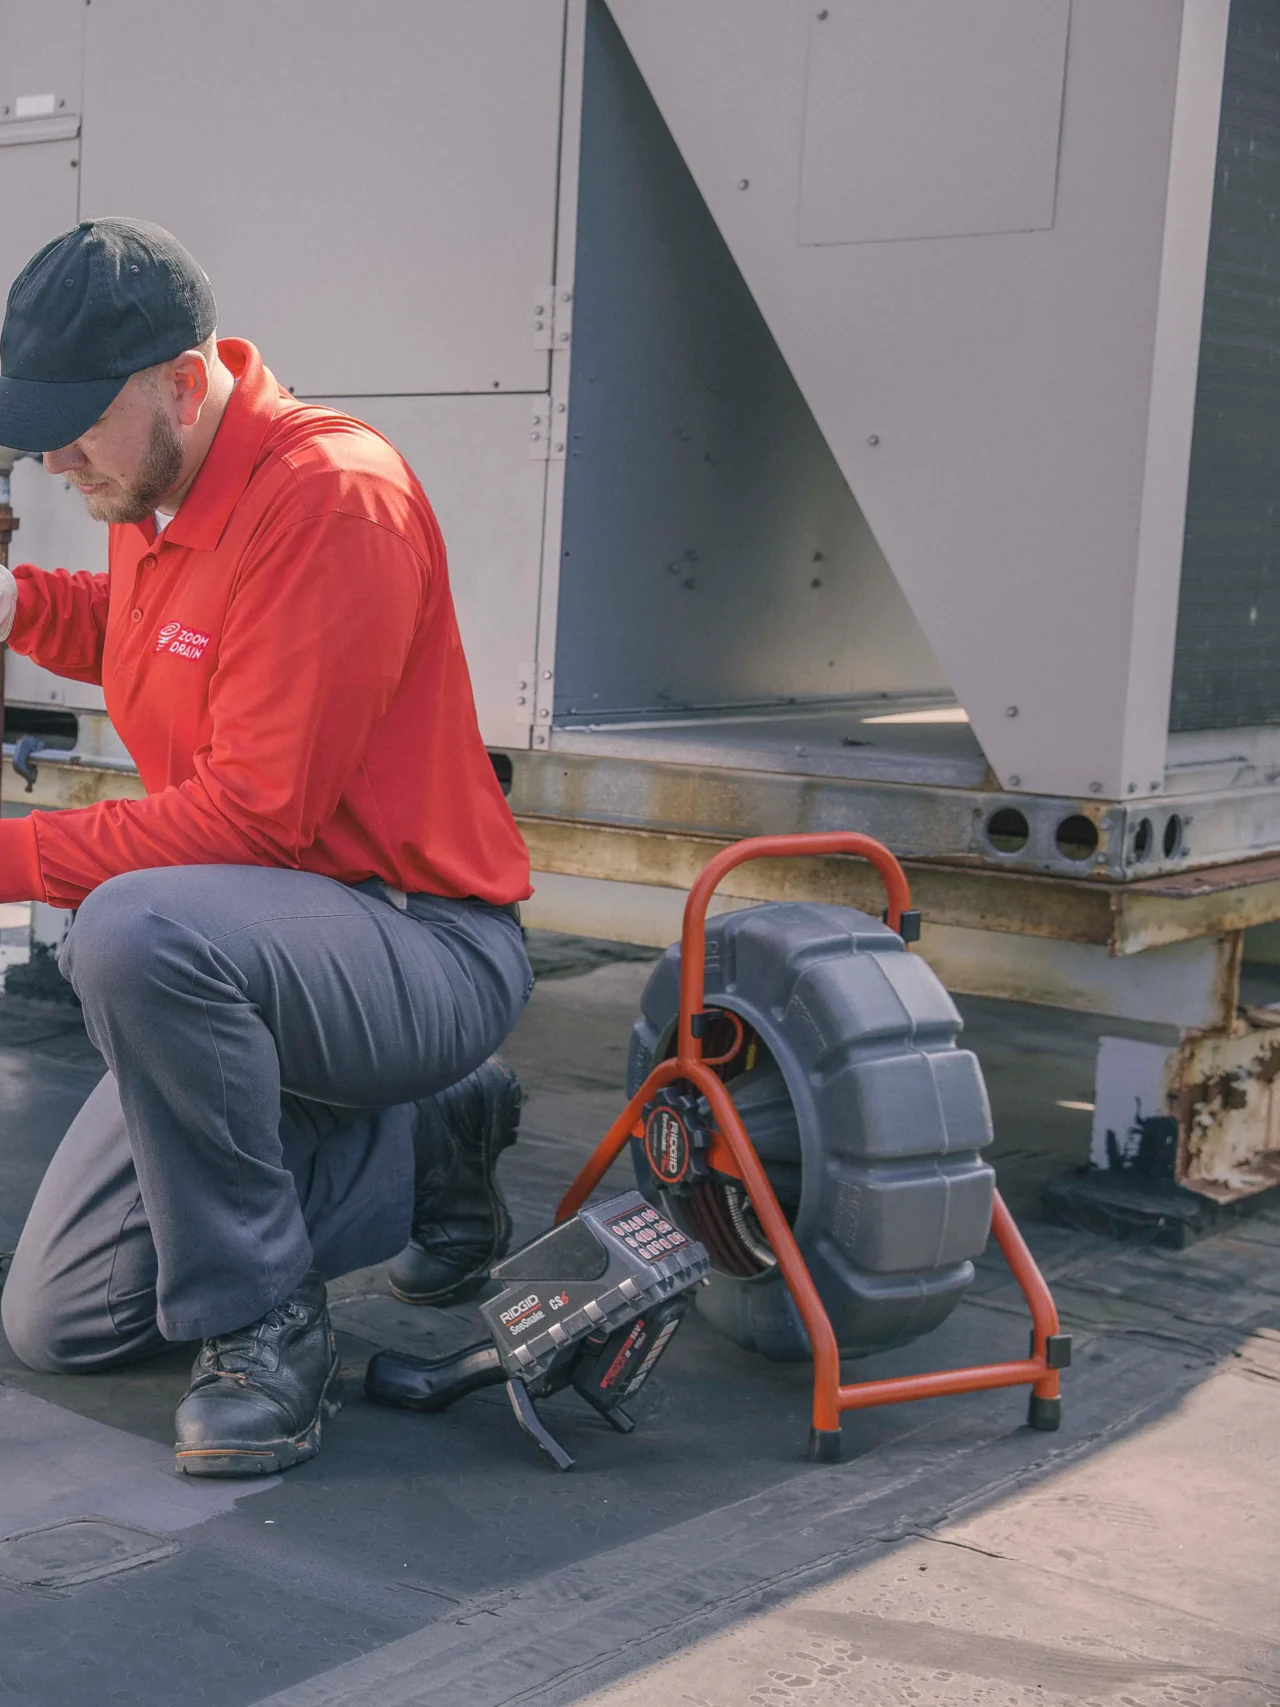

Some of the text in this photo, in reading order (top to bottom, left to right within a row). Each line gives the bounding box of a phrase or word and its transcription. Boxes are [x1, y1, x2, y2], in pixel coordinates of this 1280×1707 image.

[169, 641, 203, 659] DRAIN
[178, 630, 209, 646] ZOOM
[670, 1121, 679, 1174] RIDGID
[500, 1290, 569, 1324] RIDGID CS6
[510, 1310, 545, 1336] SeeSnake
